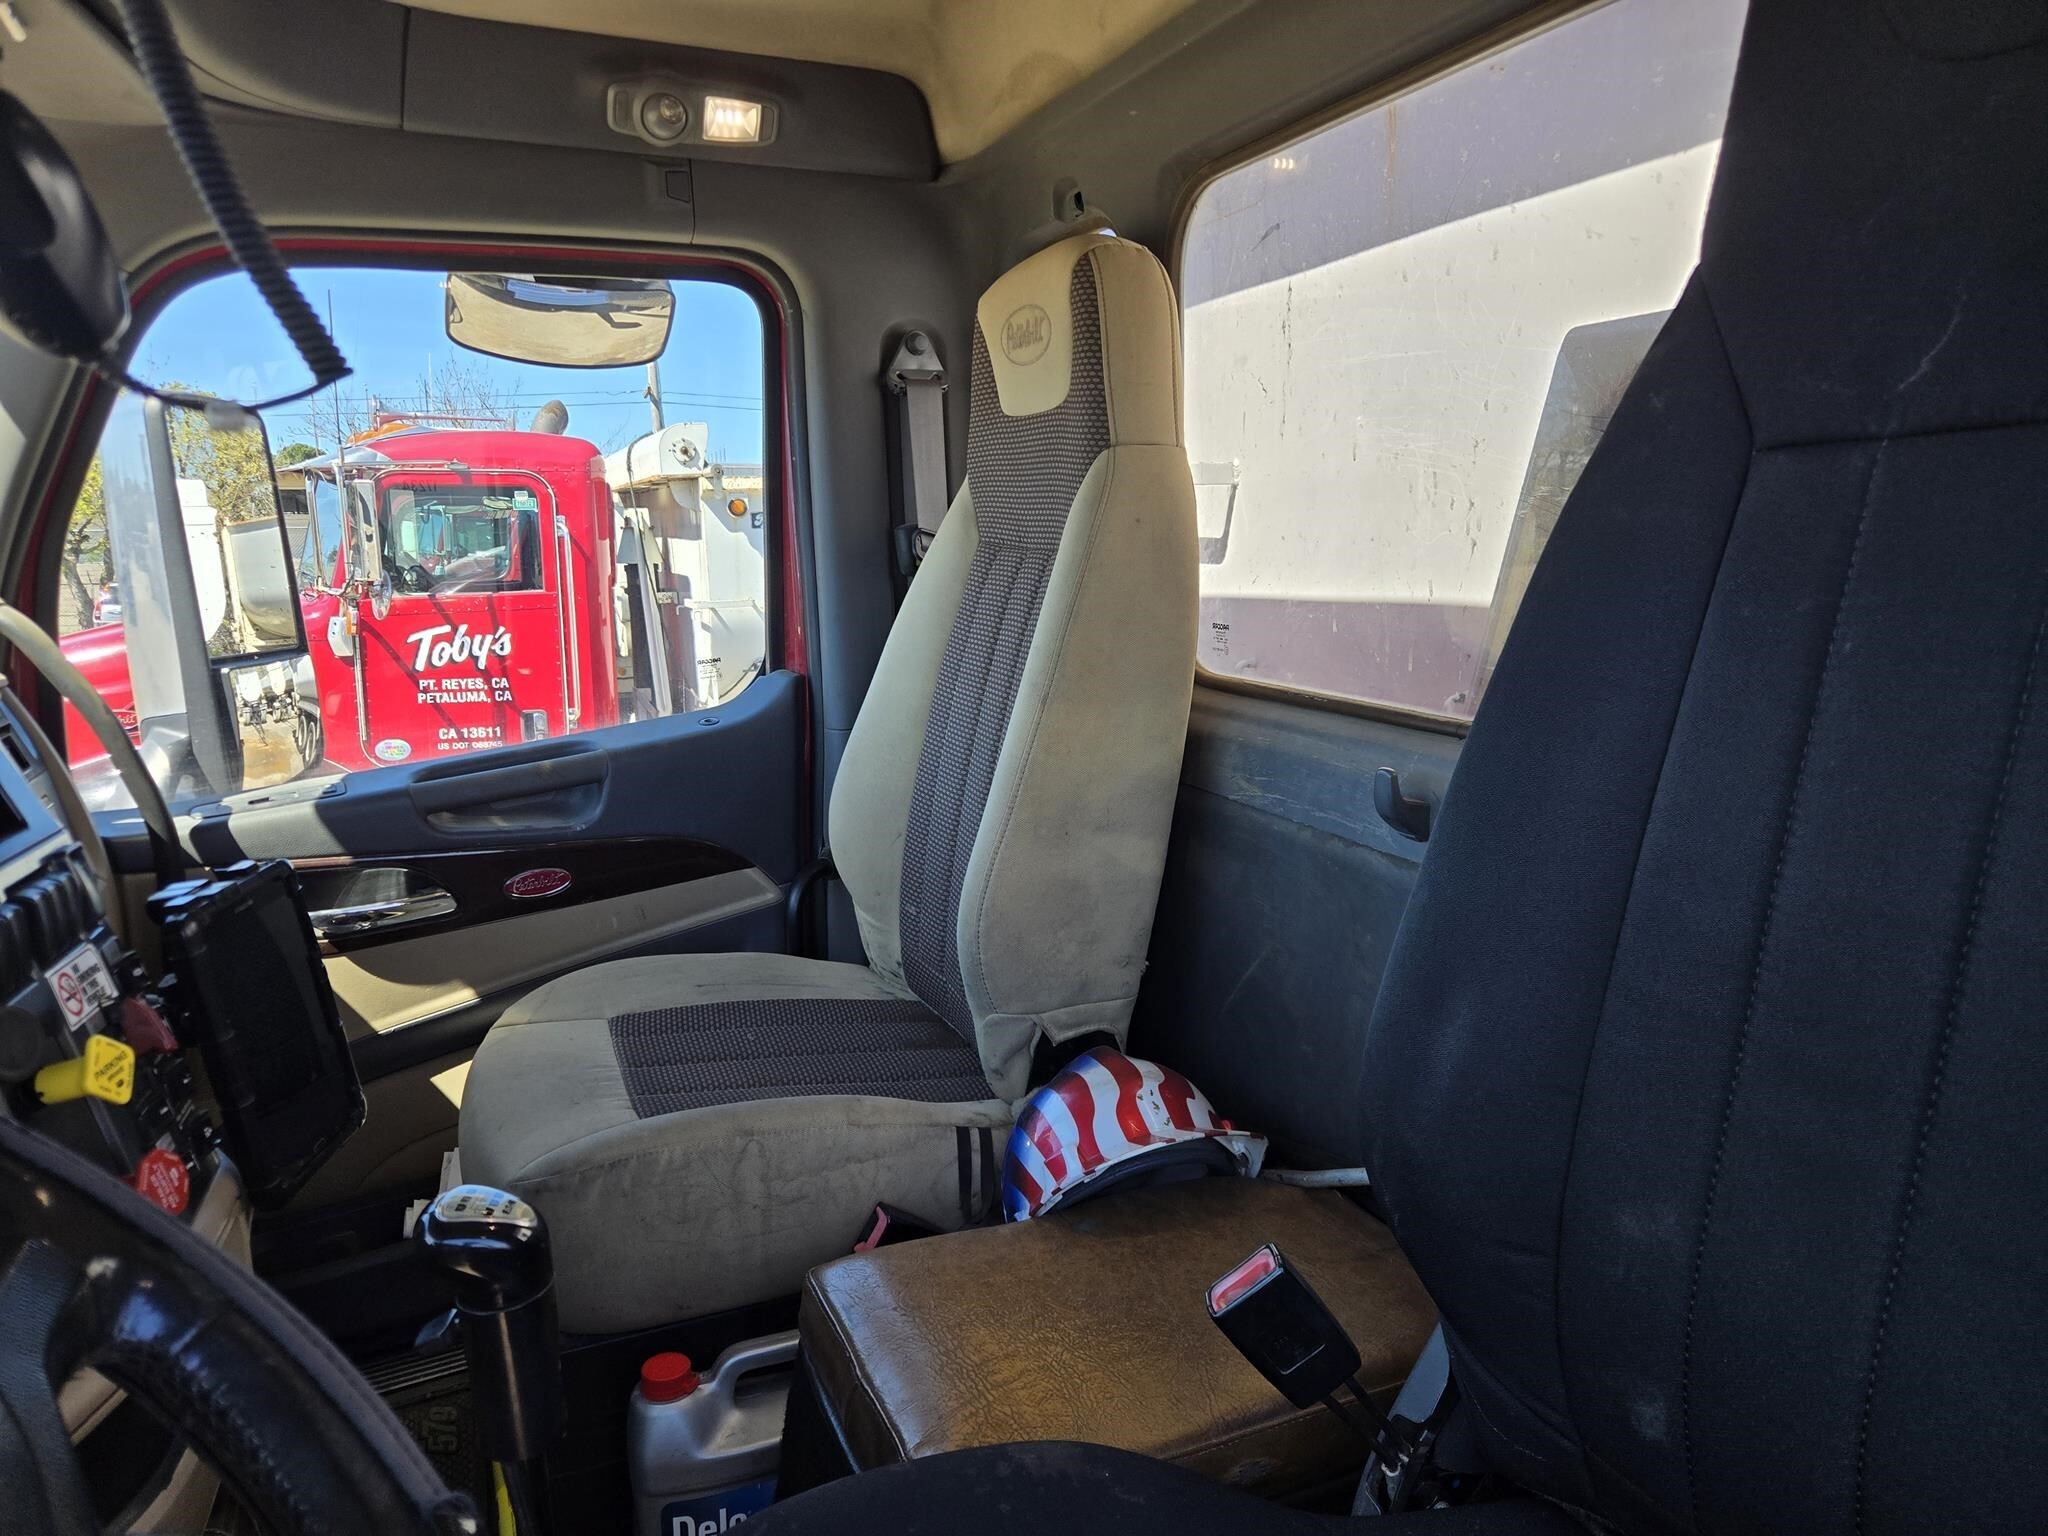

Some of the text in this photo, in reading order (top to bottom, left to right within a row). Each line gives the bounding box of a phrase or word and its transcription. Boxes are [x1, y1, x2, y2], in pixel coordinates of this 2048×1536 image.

[406, 624, 512, 672] Toby's
[419, 677, 509, 690] PT. REYES, CA
[417, 690, 512, 704] PETALUMA, CA
[438, 726, 501, 739] CA 13611
[437, 742, 450, 750] US
[452, 742, 469, 750] DOT
